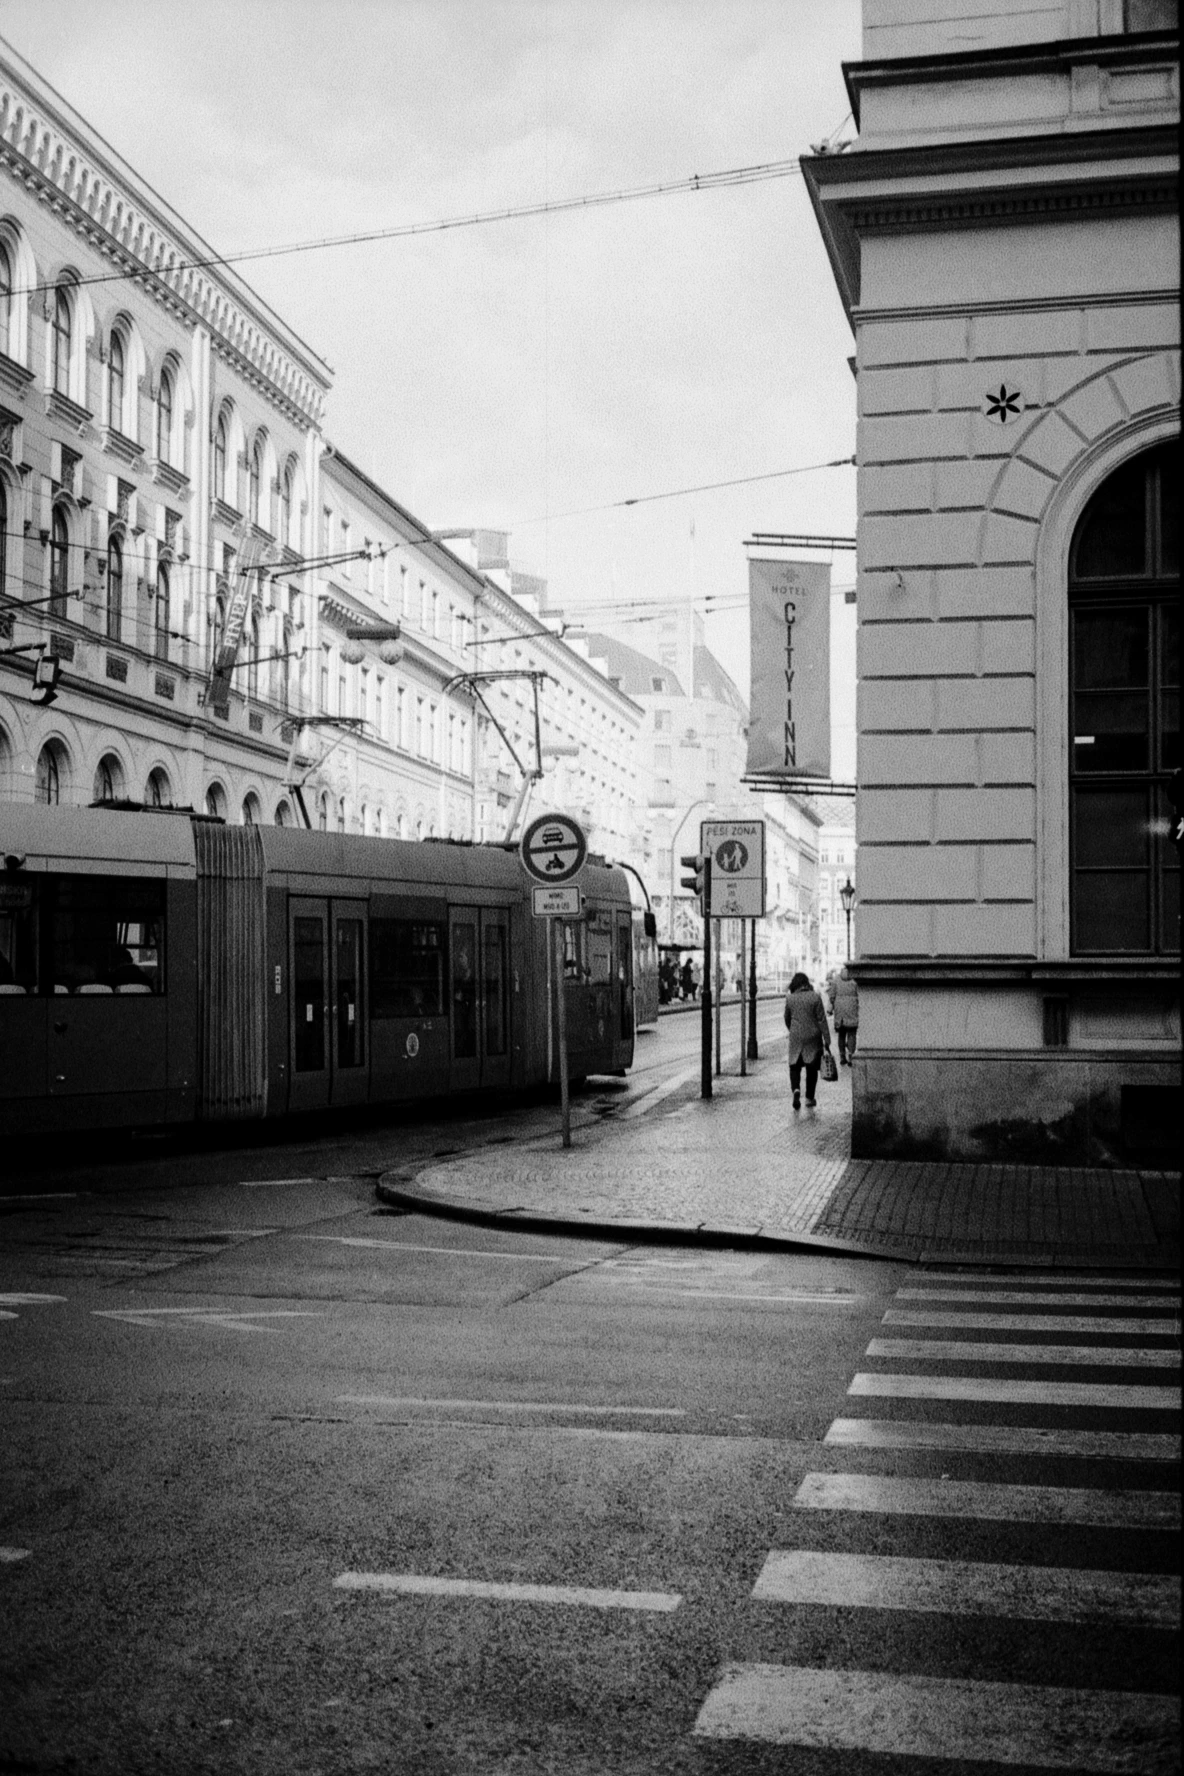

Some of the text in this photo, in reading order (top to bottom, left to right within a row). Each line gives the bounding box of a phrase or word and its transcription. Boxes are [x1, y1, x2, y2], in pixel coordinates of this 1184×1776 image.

[771, 585, 807, 597] HOTEL
[784, 602, 796, 767] CITY INN
[731, 826, 757, 836] ZONA
